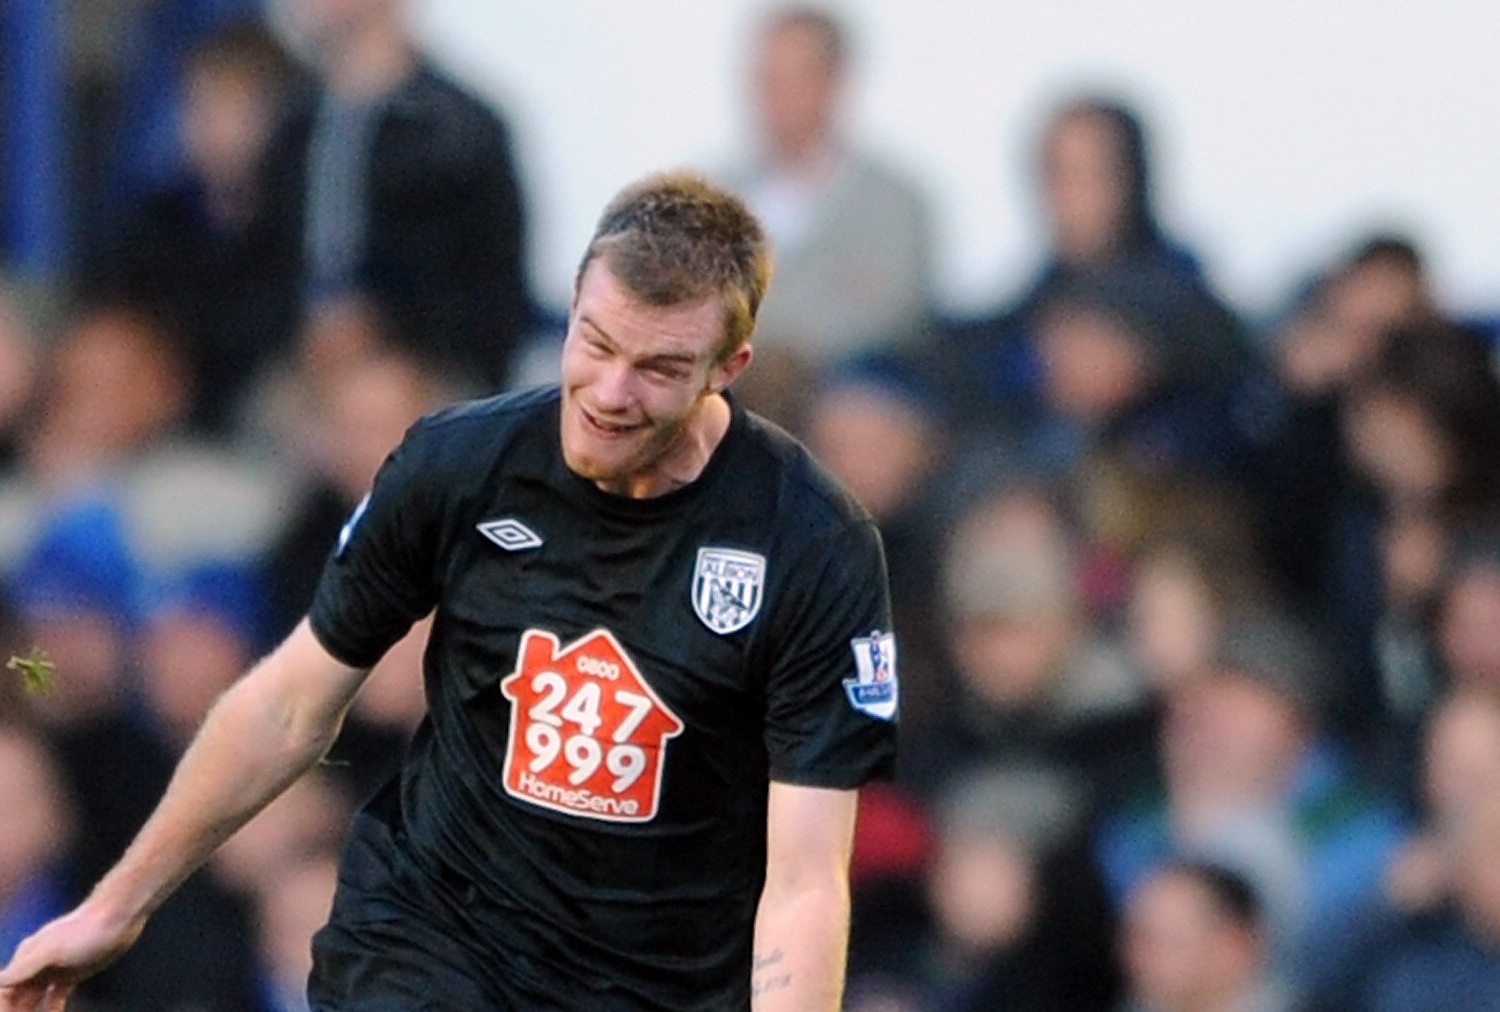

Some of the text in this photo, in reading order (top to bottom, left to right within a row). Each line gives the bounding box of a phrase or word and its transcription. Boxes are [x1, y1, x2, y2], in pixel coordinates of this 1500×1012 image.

[576, 655, 621, 681] 0800
[526, 723, 647, 793] 999
[518, 771, 640, 815] HomeServe
